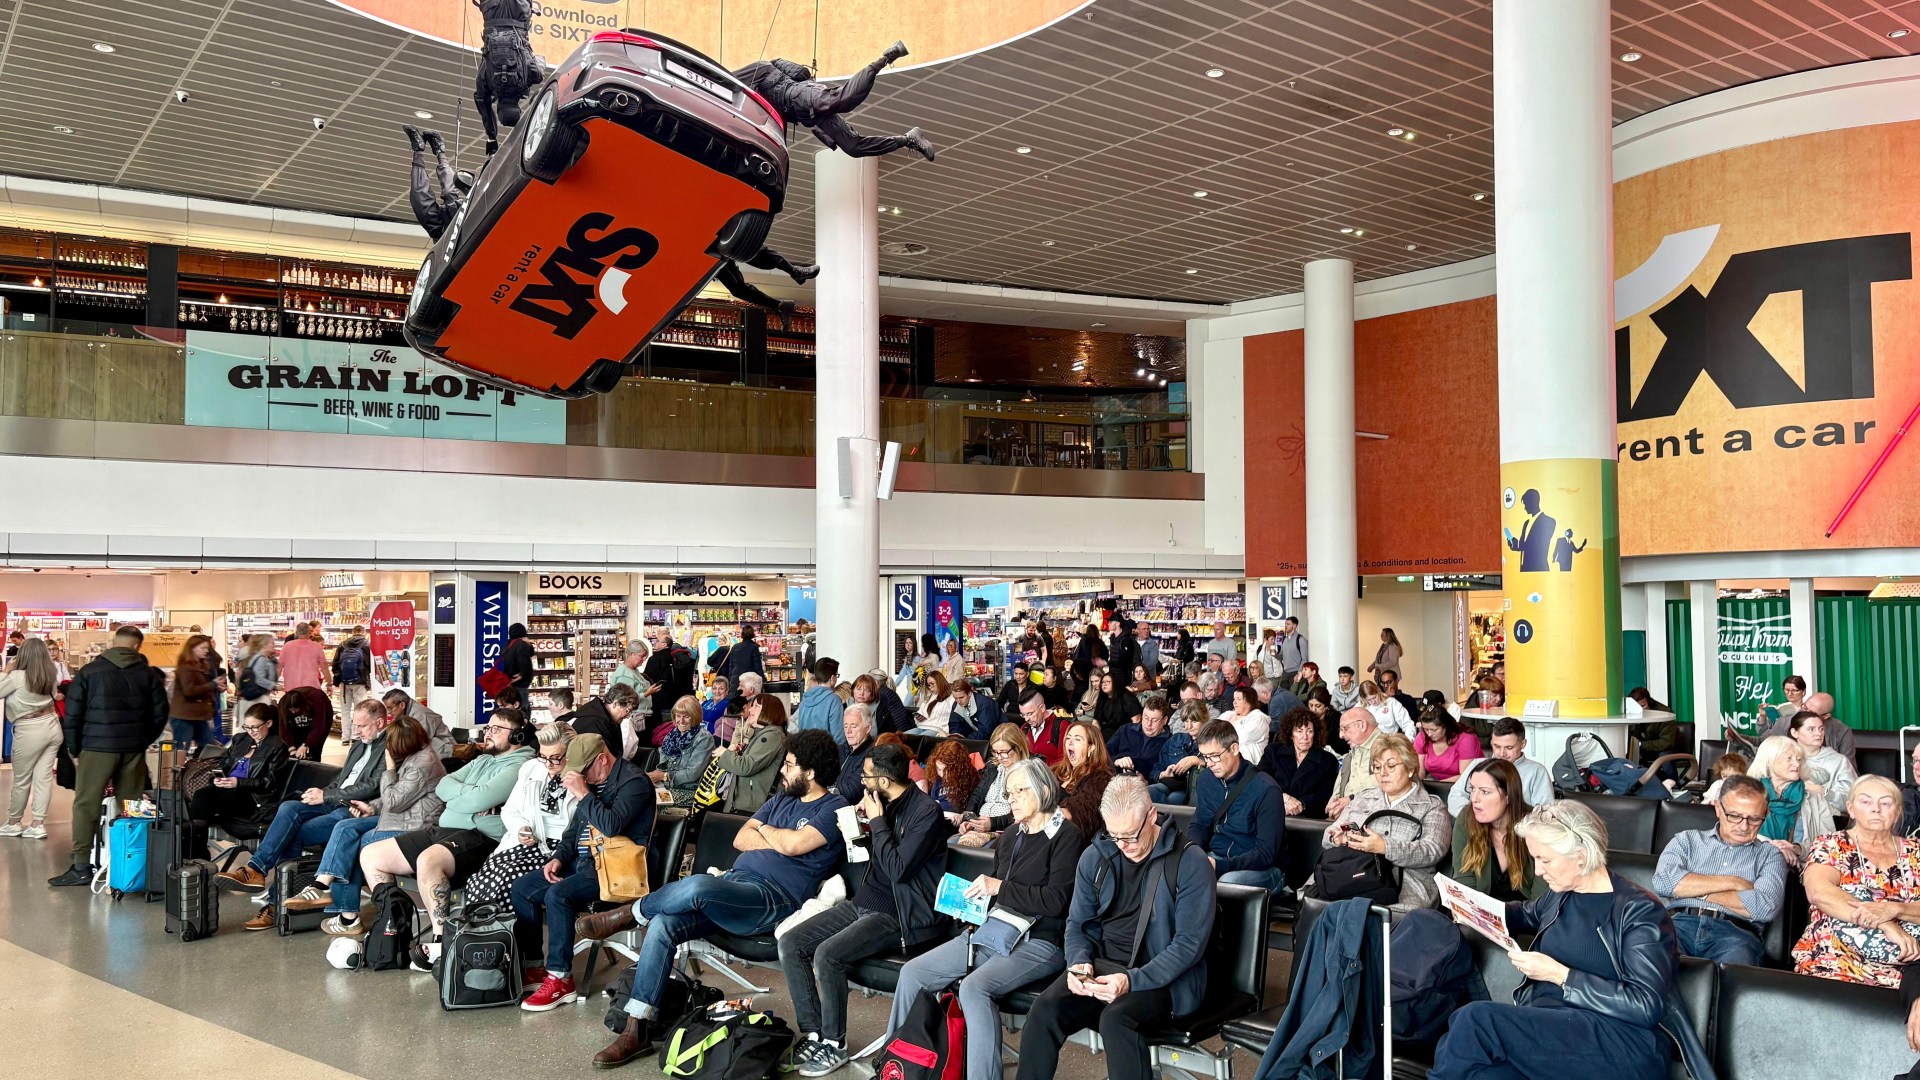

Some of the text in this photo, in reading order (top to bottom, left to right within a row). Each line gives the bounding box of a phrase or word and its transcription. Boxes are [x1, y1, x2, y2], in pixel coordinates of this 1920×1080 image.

[686, 70, 715, 90] SIXT
[490, 244, 543, 306] rent a car
[508, 211, 660, 341] SIXT
[1614, 232, 1913, 424] XT
[370, 349, 397, 364] The
[228, 364, 391, 392] GRAIN
[323, 399, 440, 421] BEER, WINE & FOOD
[1617, 420, 1876, 464] rent a car
[1371, 558, 1413, 568] conditions
[1414, 558, 1429, 566] and
[1431, 556, 1466, 565] location.
[539, 575, 602, 589] BOOKS
[899, 585, 912, 593] WH
[933, 579, 962, 589] WHSmith
[1132, 579, 1196, 590] CHOCOLATE
[644, 585, 692, 597] ELLIN
[1266, 587, 1282, 596] WH
[898, 593, 913, 620] S
[938, 606, 943, 615] 3
[946, 606, 951, 615] 2
[1267, 594, 1283, 619] S
[373, 617, 411, 627] Meal Deal
